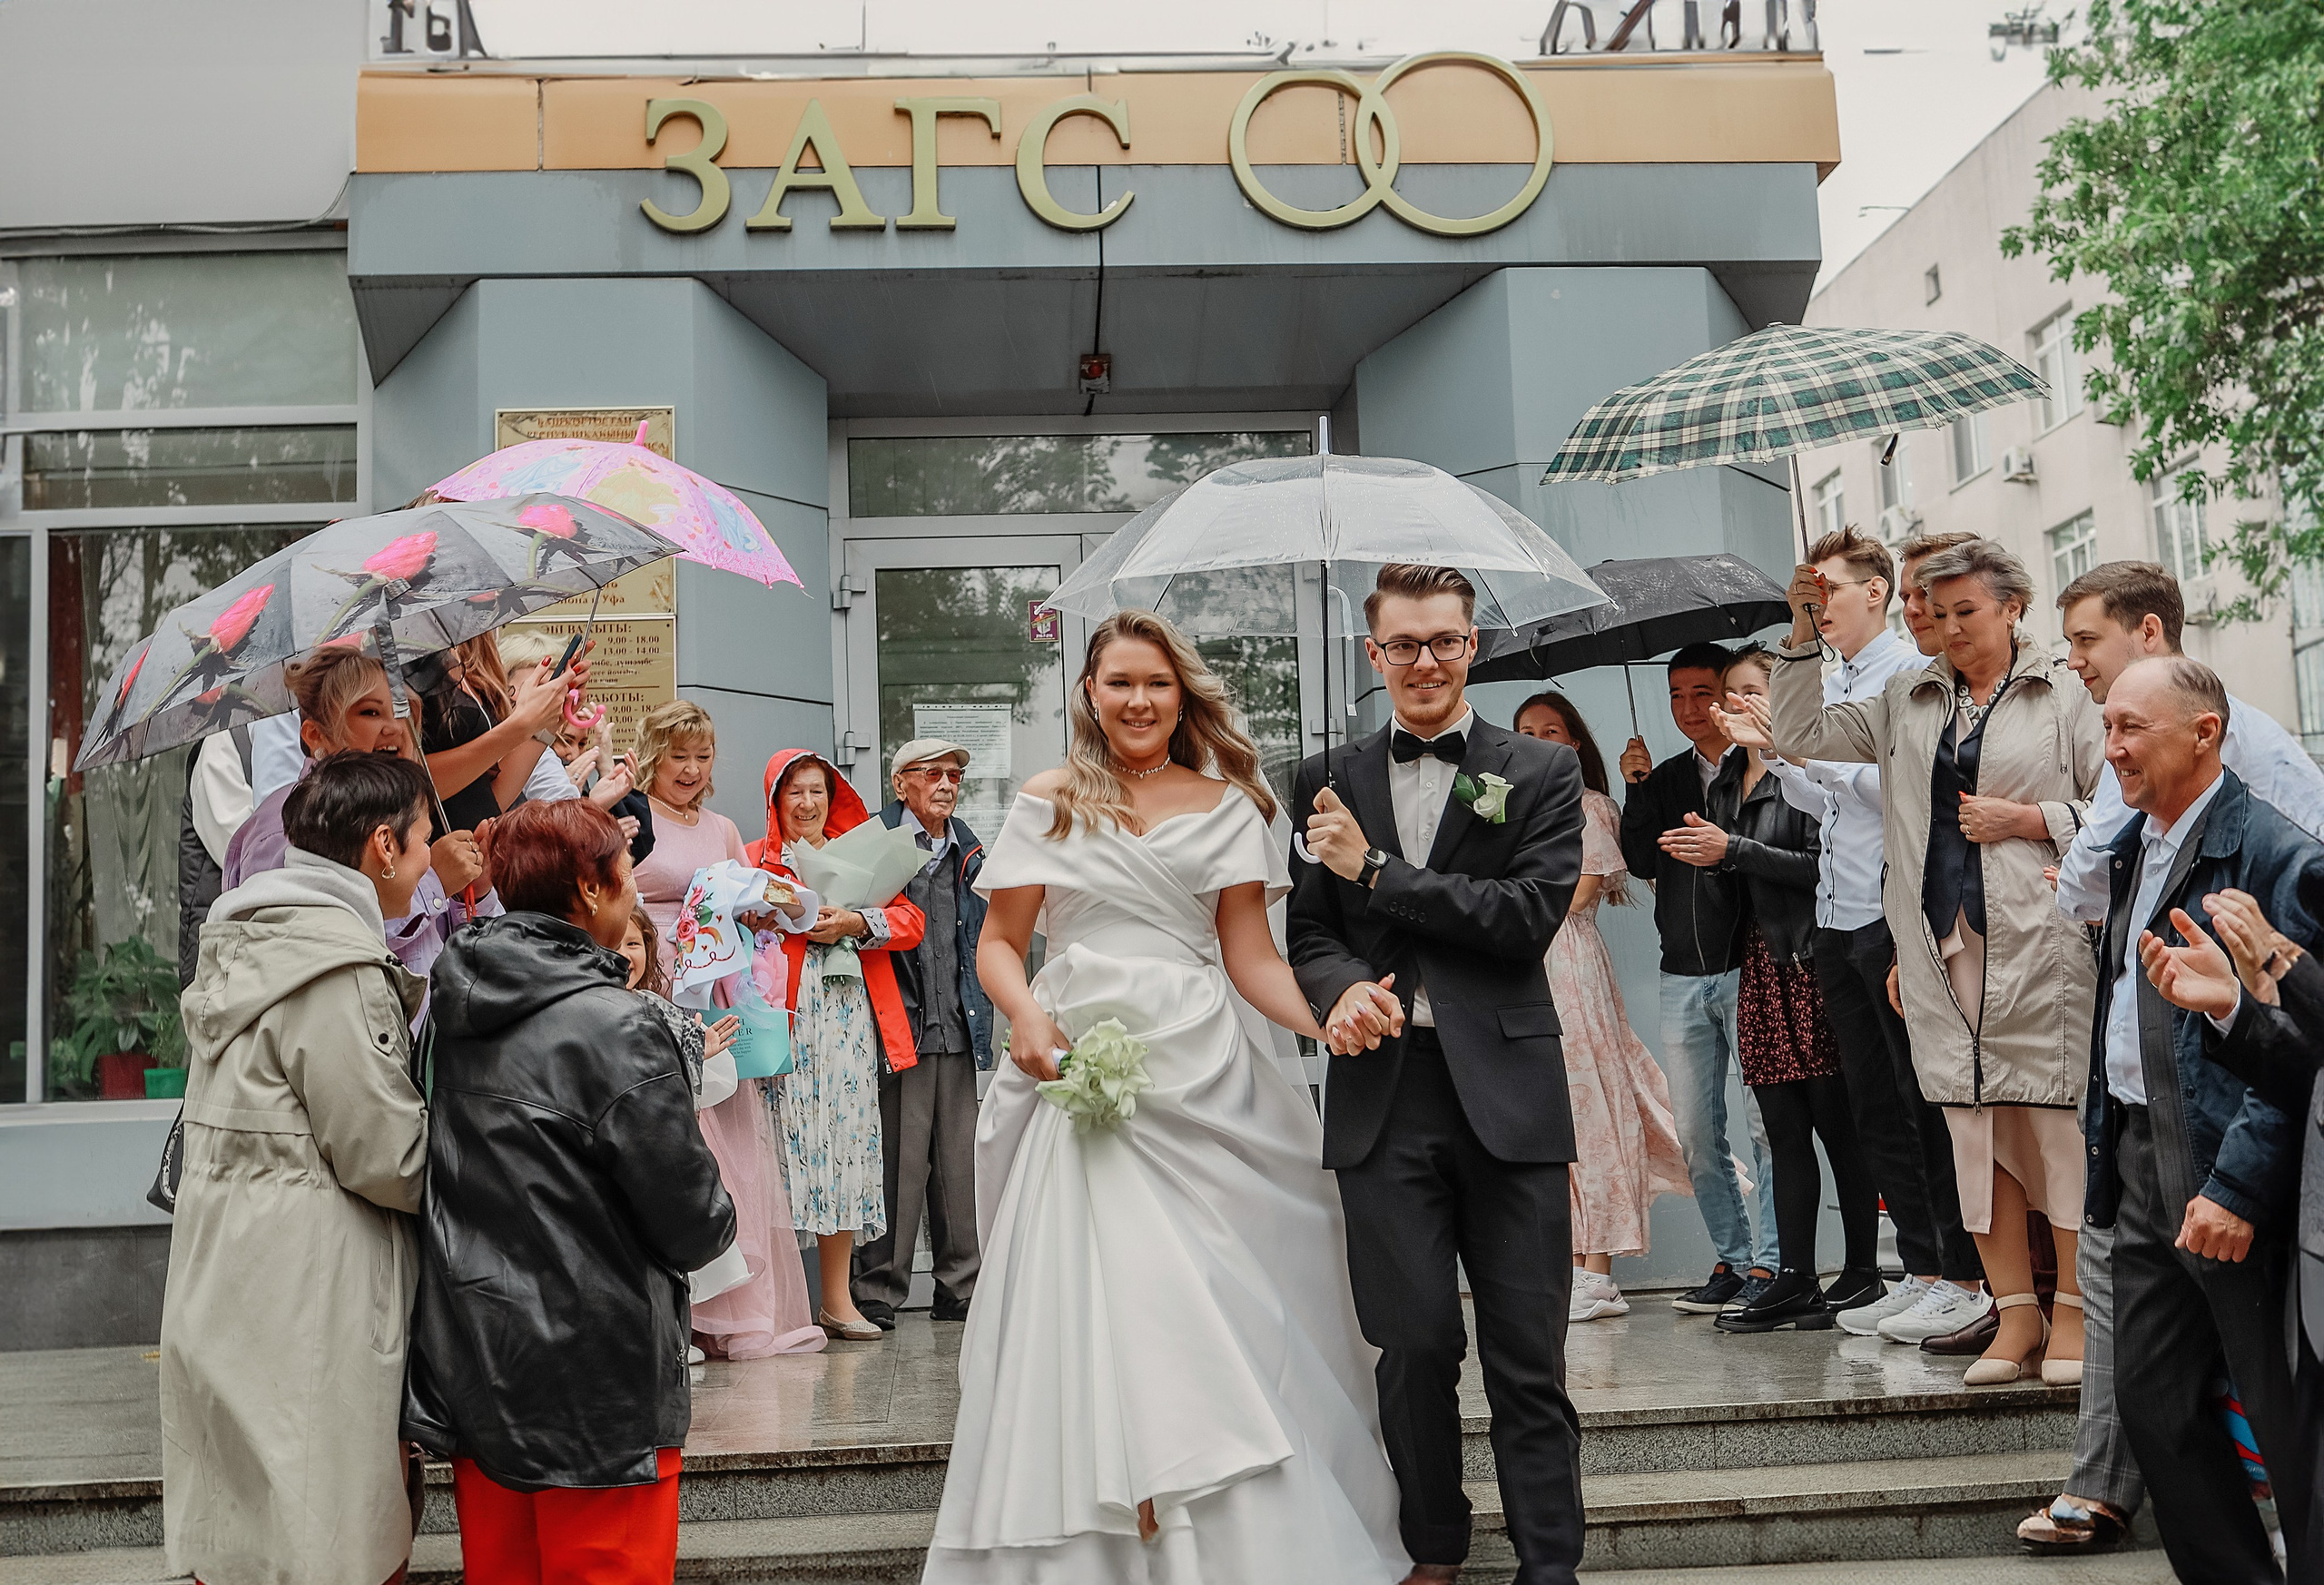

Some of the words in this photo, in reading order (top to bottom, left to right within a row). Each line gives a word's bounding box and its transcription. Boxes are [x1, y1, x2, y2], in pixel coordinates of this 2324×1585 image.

[639, 97, 1136, 234] ЗАГС
[602, 594, 625, 605] Уфа
[586, 693, 645, 703] РАБОТЫ:
